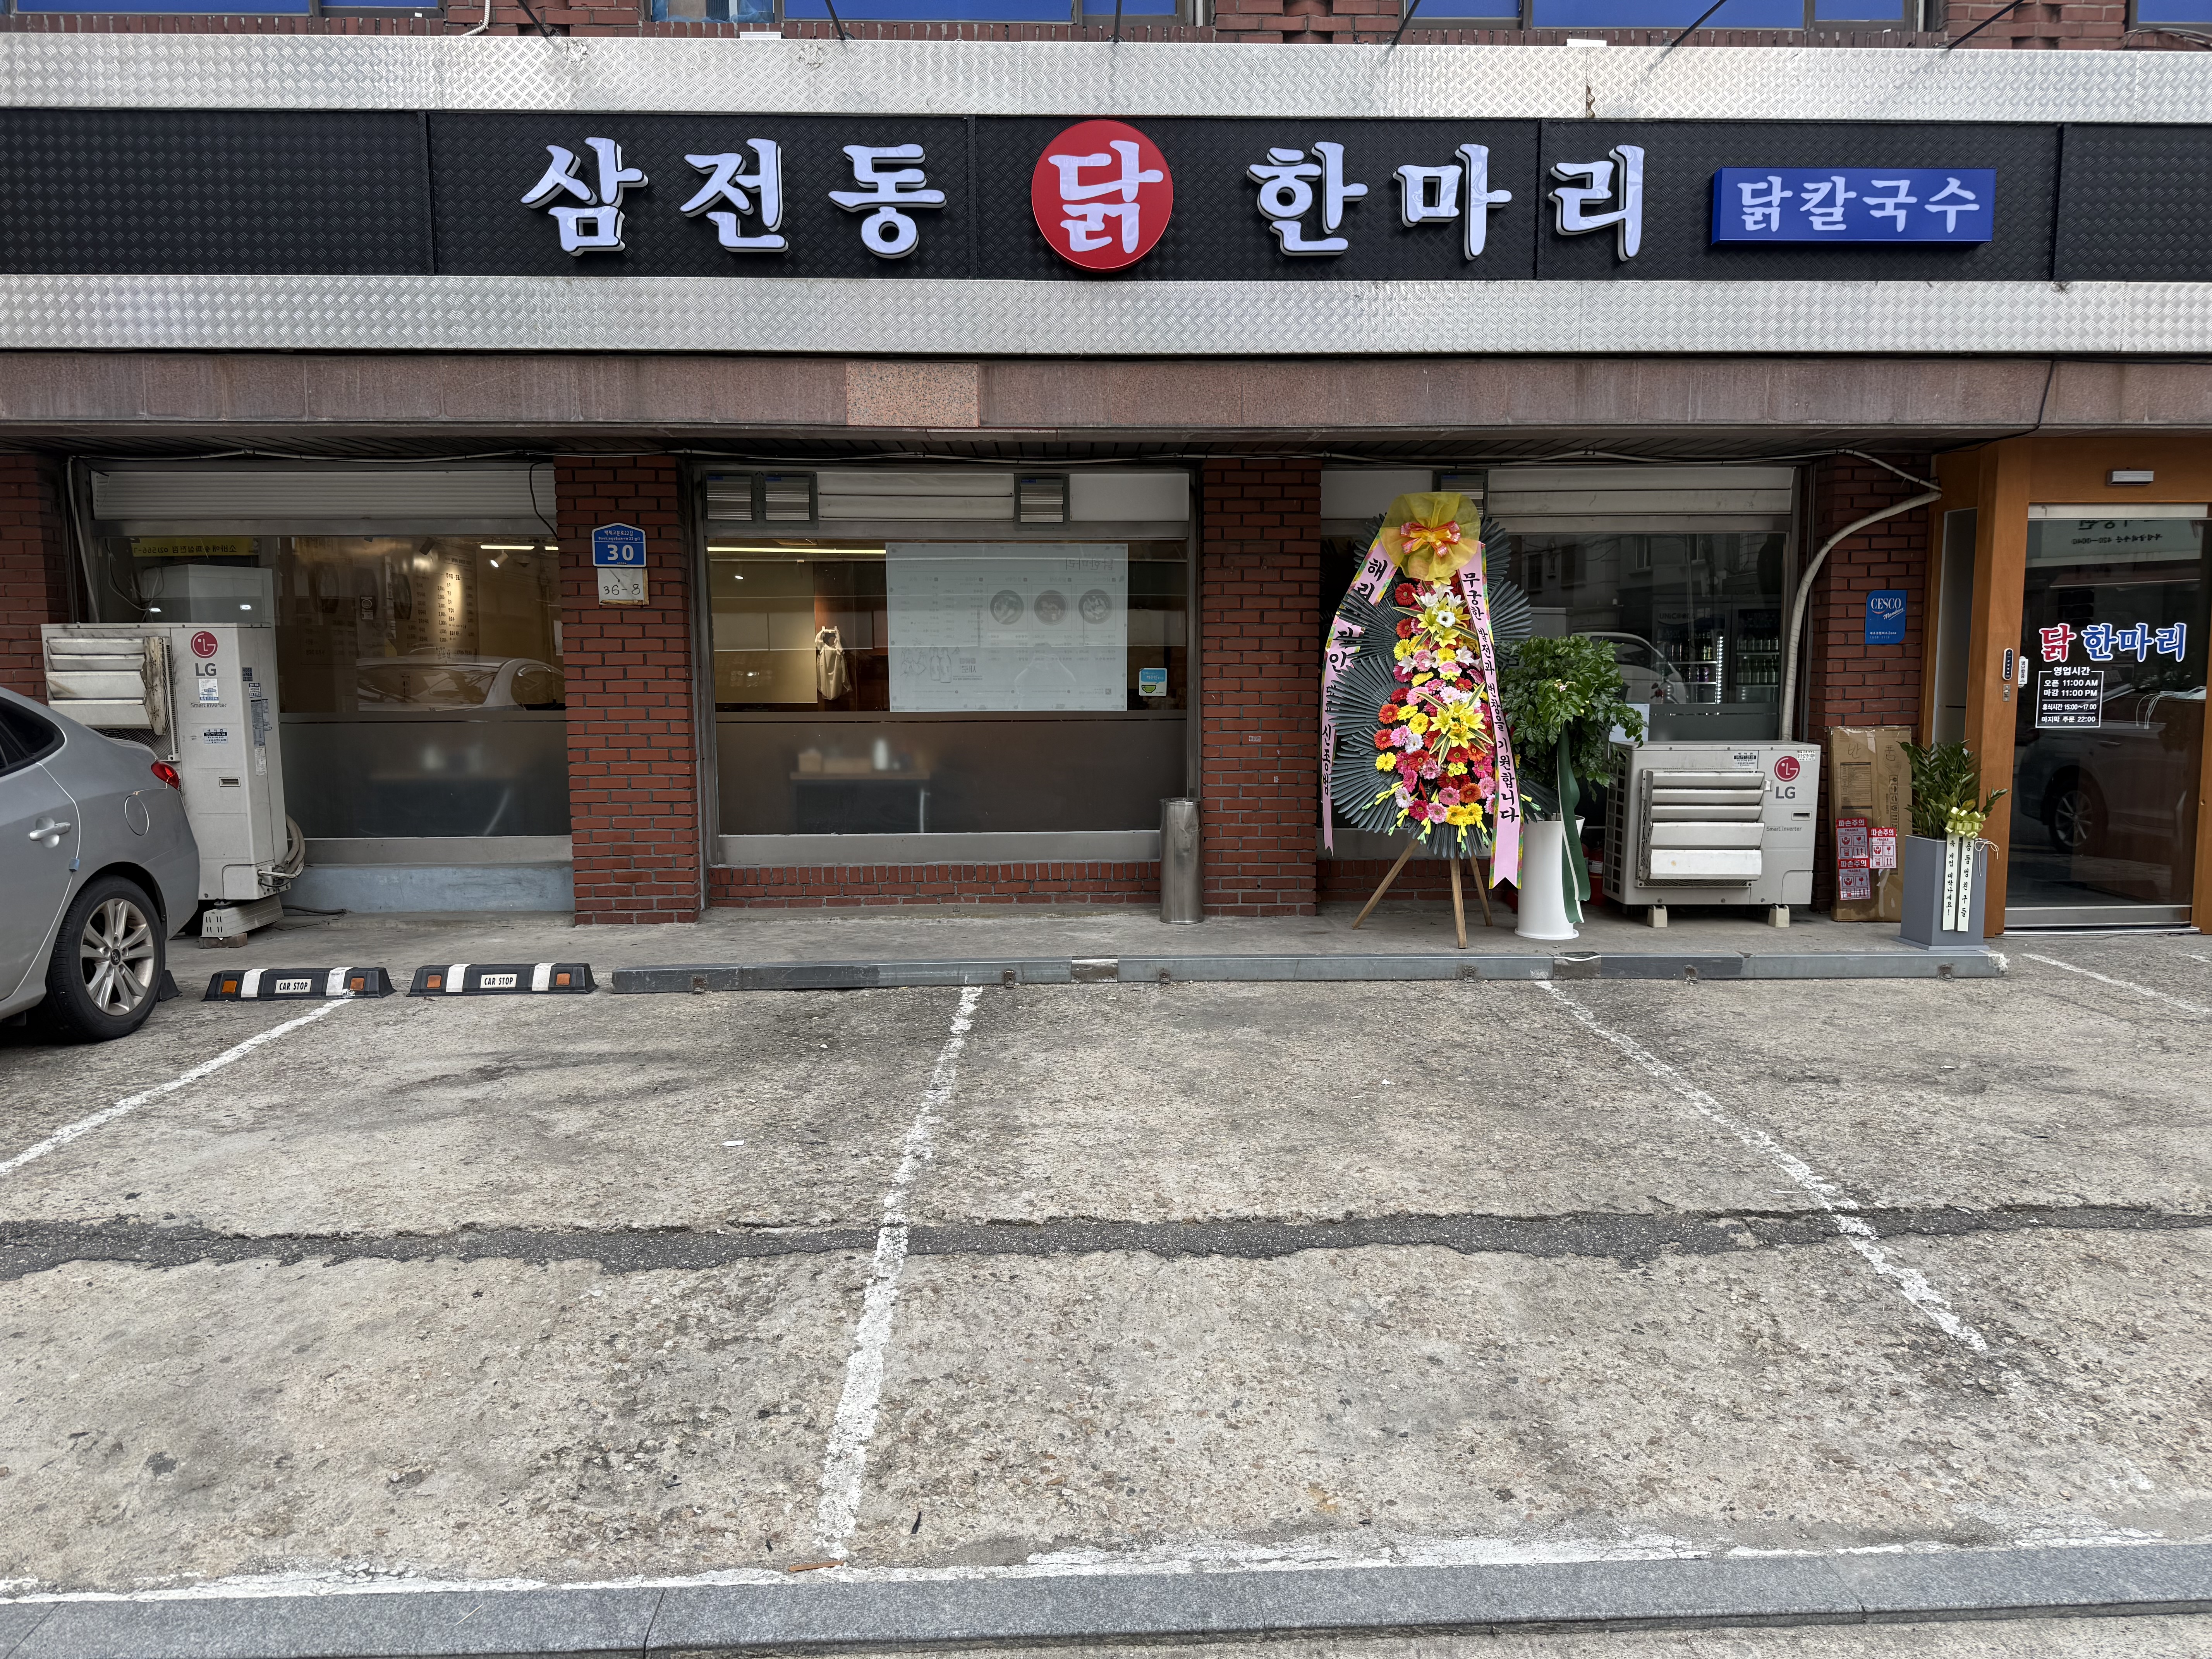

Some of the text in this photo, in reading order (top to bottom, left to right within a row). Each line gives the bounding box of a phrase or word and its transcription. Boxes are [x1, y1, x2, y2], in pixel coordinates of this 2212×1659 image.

[521, 137, 1645, 261] 삼전동 닭 한마리
[1738, 176, 1980, 233] 닭칼국수
[608, 545, 634, 561] 30
[603, 584, 641, 595] 36-8
[1871, 598, 1902, 609] CESCO
[2039, 622, 2187, 662] 닭 한마리
[195, 663, 216, 676] LG
[2053, 666, 2090, 676] 영업시간
[1462, 572, 1519, 823] 무궁한 발전과 번창을 기원합니다
[1775, 786, 1796, 799] LG
[1949, 853, 1954, 867] 개업
[279, 981, 308, 991] CAR STOP
[484, 977, 513, 987] CAR STOP
